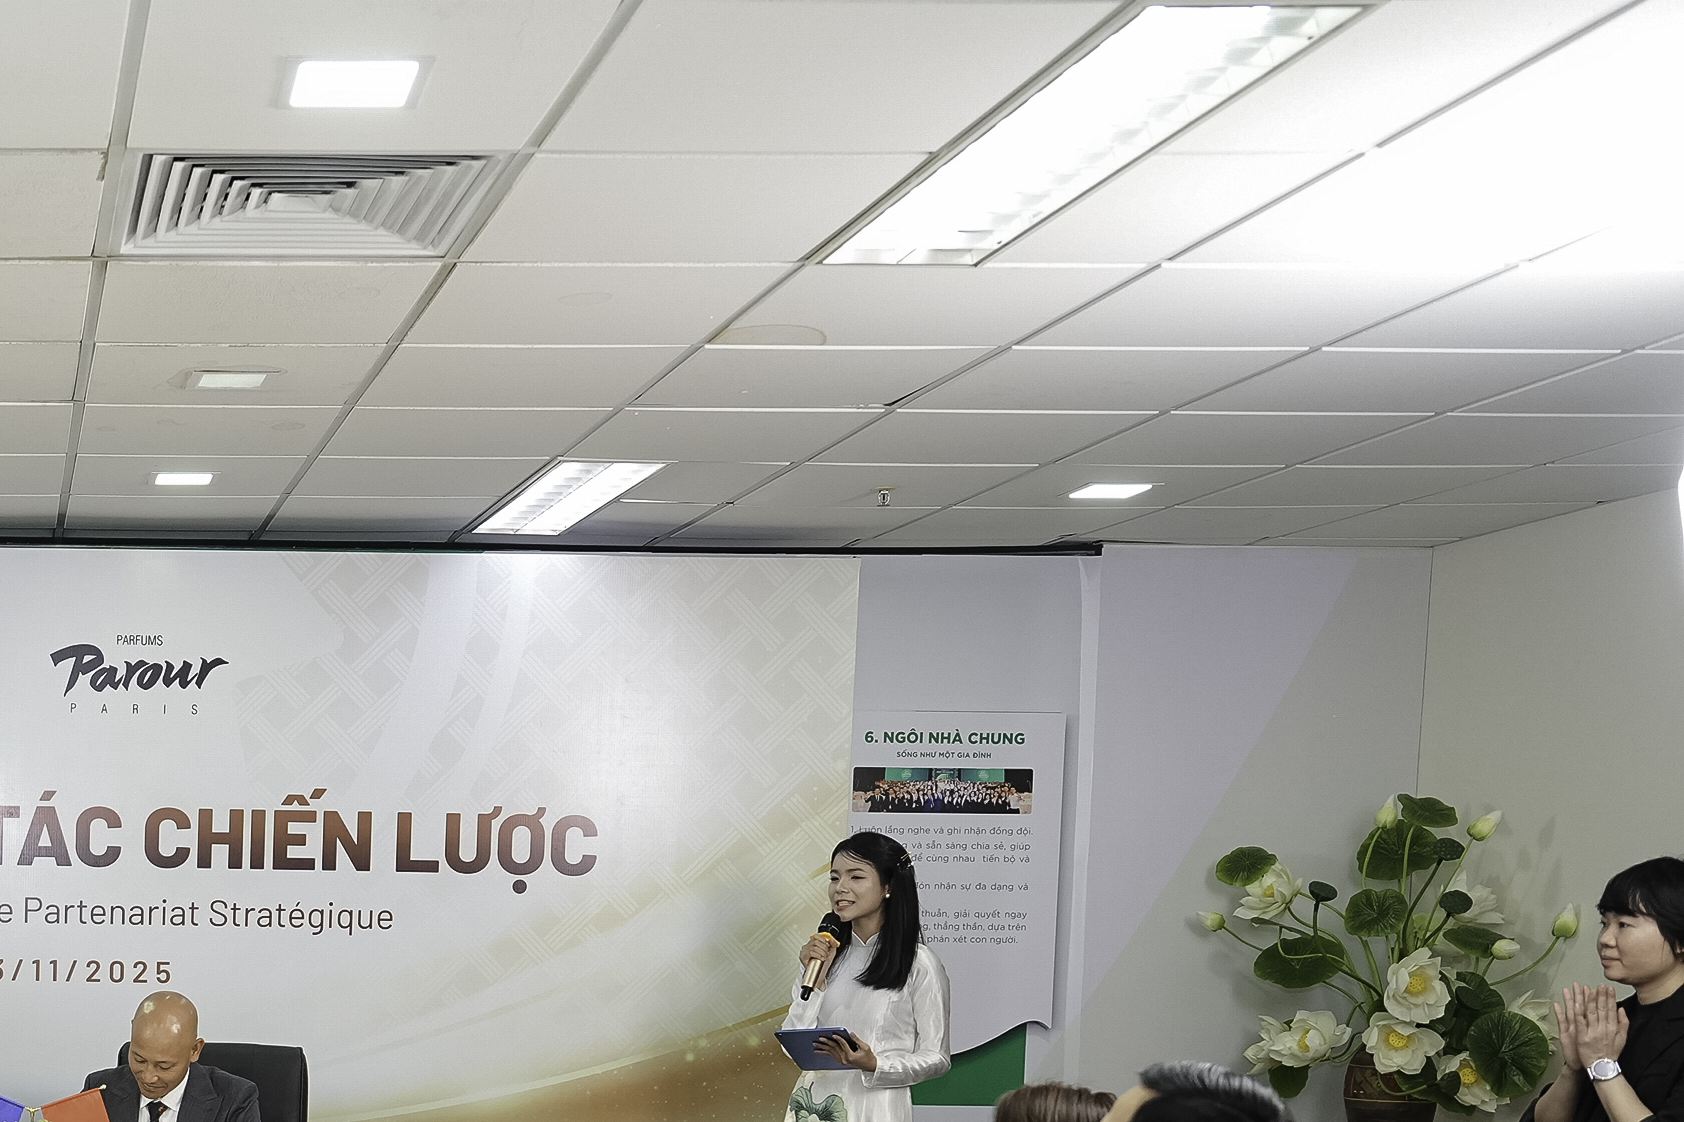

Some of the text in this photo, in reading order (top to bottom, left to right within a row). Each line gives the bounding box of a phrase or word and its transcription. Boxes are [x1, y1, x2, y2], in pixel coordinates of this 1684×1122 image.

[116, 634, 164, 647] PARFUMS
[50, 644, 229, 697] Parour
[70, 702, 198, 716] PARIS
[864, 727, 1026, 746] 6. NGÔI NHÀ CHUNG
[896, 749, 992, 760] SỐNG NHƯ MỘT GIA ĐÌNH
[885, 824, 905, 836] lắng
[907, 825, 931, 836] nghe
[933, 826, 945, 835] và
[946, 826, 962, 837] ghi
[963, 826, 987, 837] nhận
[988, 825, 1014, 837] đồng
[1015, 826, 1034, 837] đội.
[145, 788, 372, 871] CHIẾN
[396, 806, 597, 894] LƯỢC
[911, 840, 923, 850] và
[945, 841, 968, 852] sàng
[970, 841, 991, 851] chia
[993, 841, 1007, 851] sẻ,
[1009, 841, 1031, 852] giúp
[925, 853, 950, 864] cùng
[952, 854, 976, 863] nhau
[982, 853, 1000, 863] tiến
[1003, 854, 1016, 865] bộ
[1018, 854, 1030, 864] và
[917, 881, 1029, 893] ón nhận sự đa dạng và
[24, 896, 200, 927] Partenariat
[209, 899, 394, 937] Stratégique
[953, 908, 971, 920] giải
[973, 908, 1001, 920] quyết
[1004, 911, 1028, 921] ngay
[933, 920, 960, 933] thẳng
[987, 922, 1006, 933] dựa
[1007, 922, 1027, 932] trên
[926, 934, 1019, 946] phán xét con người.
